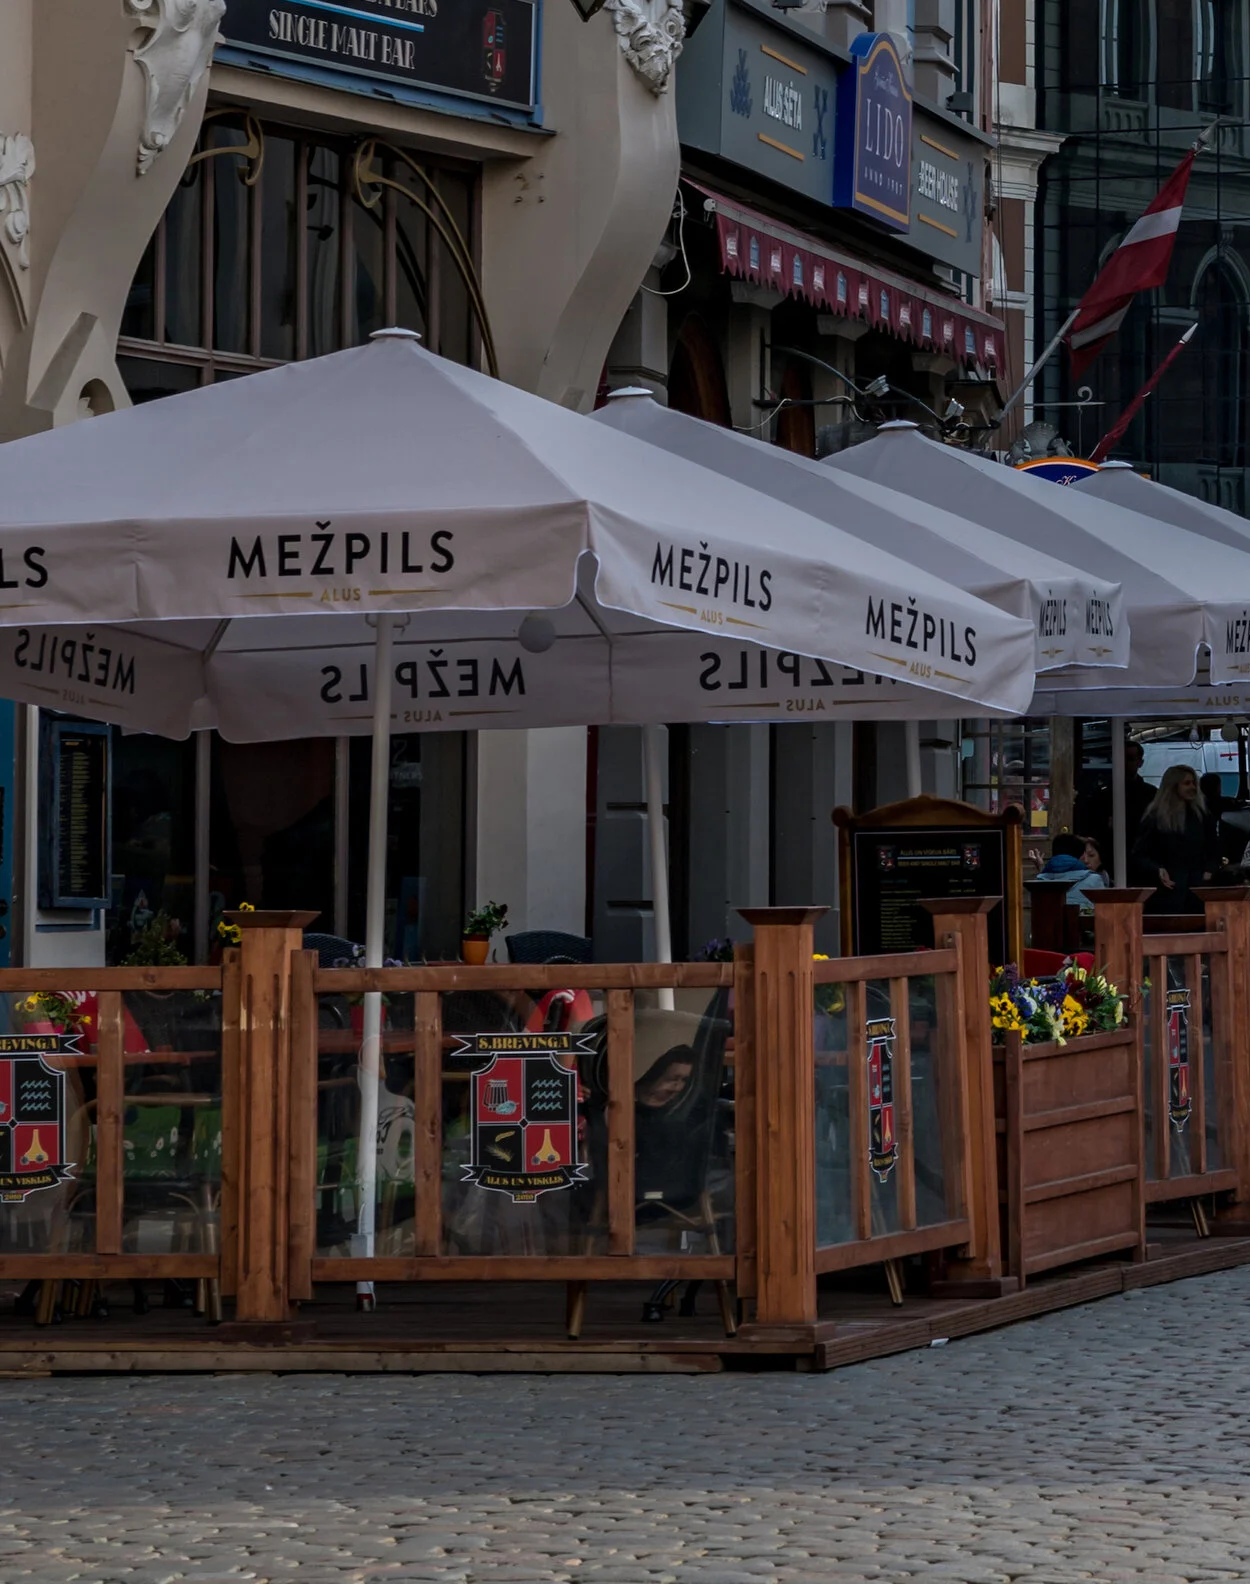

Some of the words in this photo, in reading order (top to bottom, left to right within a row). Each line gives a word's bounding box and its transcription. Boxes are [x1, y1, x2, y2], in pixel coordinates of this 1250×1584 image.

[268, 9, 328, 53] SINGLE
[330, 24, 379, 61] MALT
[381, 35, 416, 70] BAR
[865, 98, 904, 168] LIDO
[226, 520, 456, 579] MEŽPILS
[320, 587, 362, 603] ALUS
[651, 540, 773, 612] MEŽPILS
[700, 609, 724, 627] ALUS
[865, 595, 977, 667] MEŽPILS
[909, 660, 932, 680] ALUS
[1205, 695, 1240, 707] ALUS
[478, 1036, 570, 1050] S.BREVINGA
